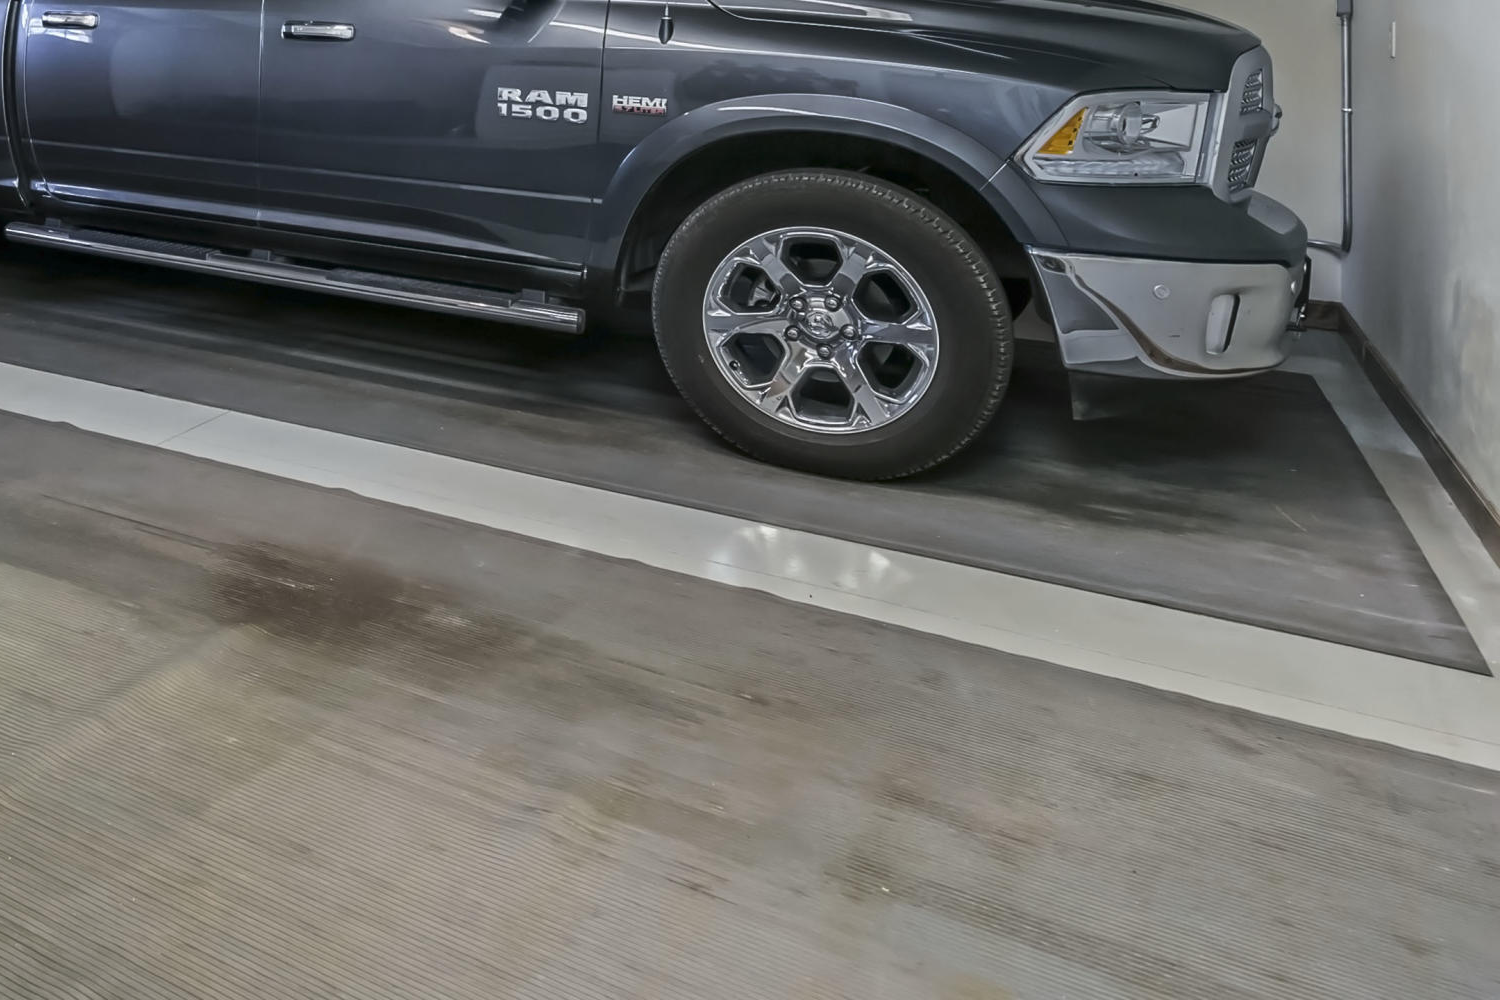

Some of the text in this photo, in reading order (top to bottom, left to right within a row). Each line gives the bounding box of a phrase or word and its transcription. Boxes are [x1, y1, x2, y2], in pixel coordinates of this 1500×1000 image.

[497, 87, 588, 108] RAM
[612, 94, 667, 109] HEMI
[497, 102, 588, 124] 1500
